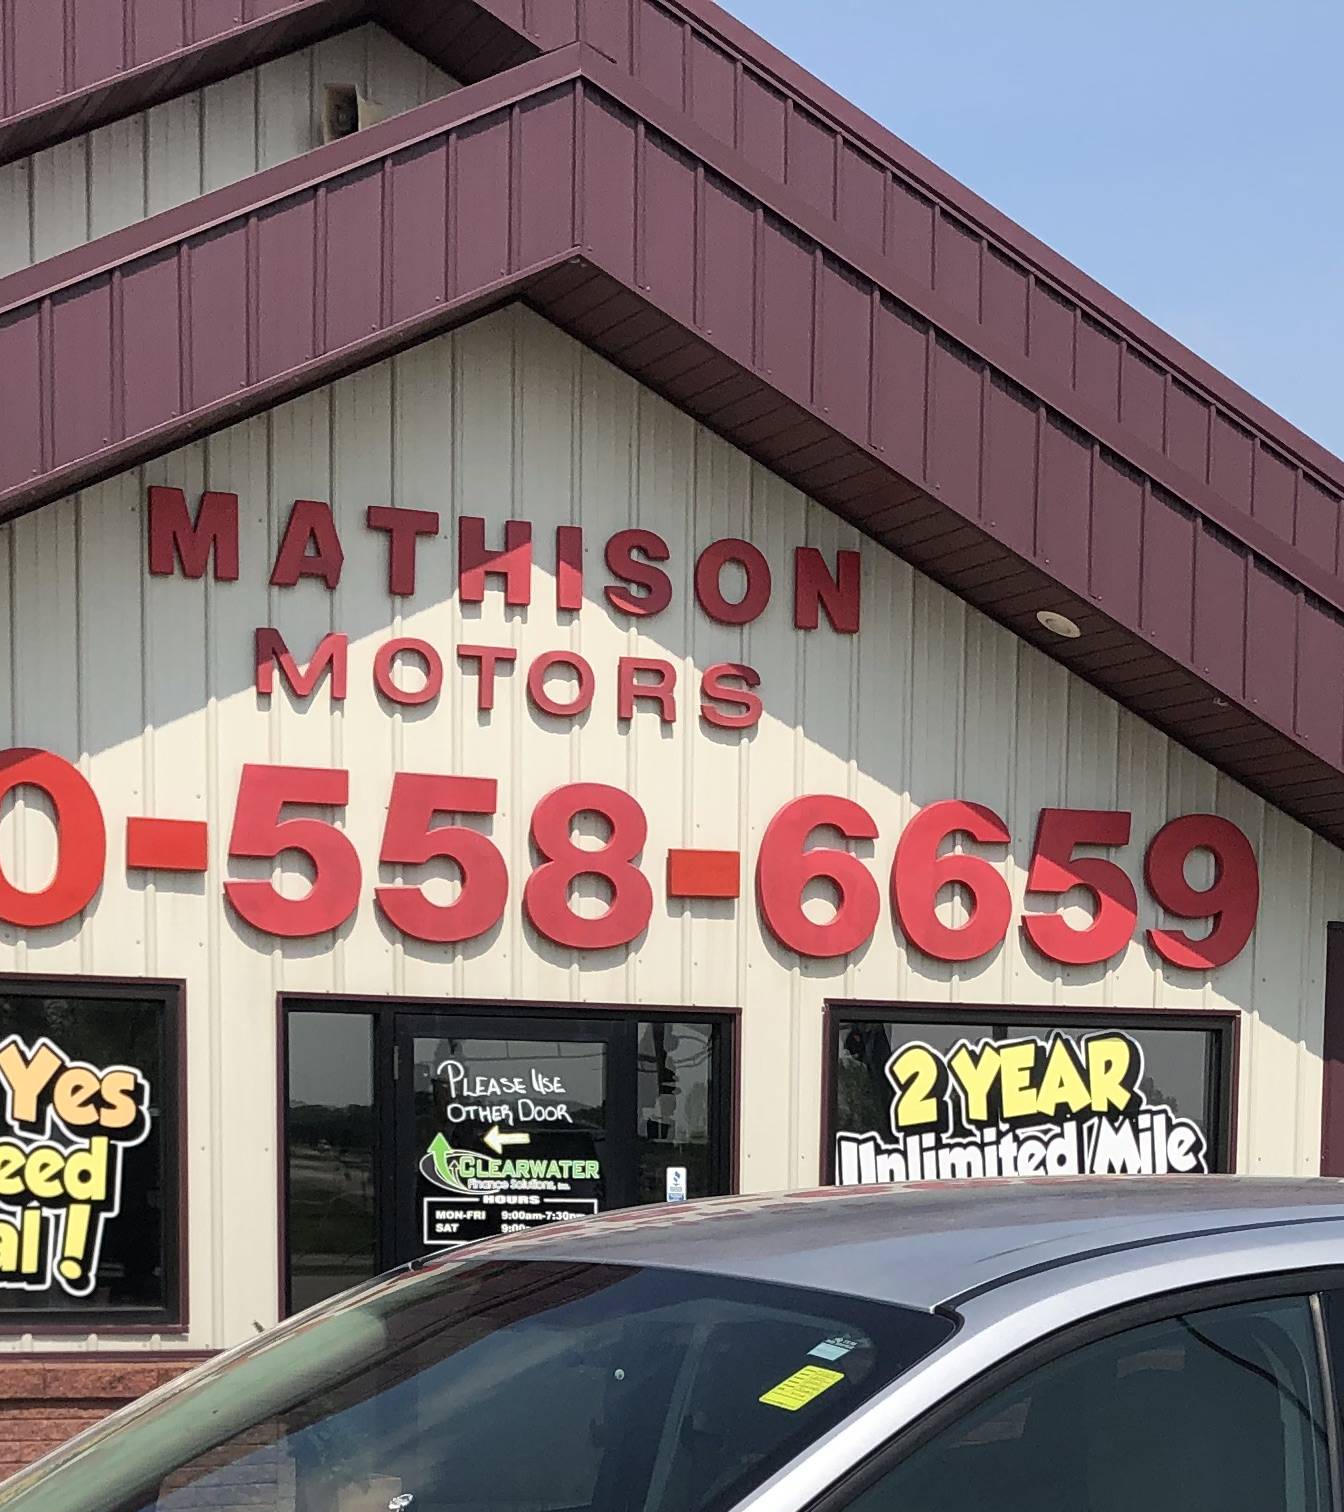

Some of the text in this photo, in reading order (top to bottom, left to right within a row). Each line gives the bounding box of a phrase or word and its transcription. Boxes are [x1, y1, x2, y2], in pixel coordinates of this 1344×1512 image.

[147, 485, 861, 635] MATHISON
[256, 627, 763, 731] MOTORS
[436, 1060, 566, 1098] PLEASE USE
[892, 1038, 1132, 1126] 2 YEAR
[447, 1099, 573, 1126] OTHER DOOR
[838, 1121, 1079, 1186] Unlimited
[459, 1156, 600, 1179] CLEARWATER
[467, 1178, 509, 1190] Finance
[482, 1195, 541, 1205] HOURS
[435, 1210, 487, 1221] MON-FRI
[435, 1223, 460, 1233] SAT
